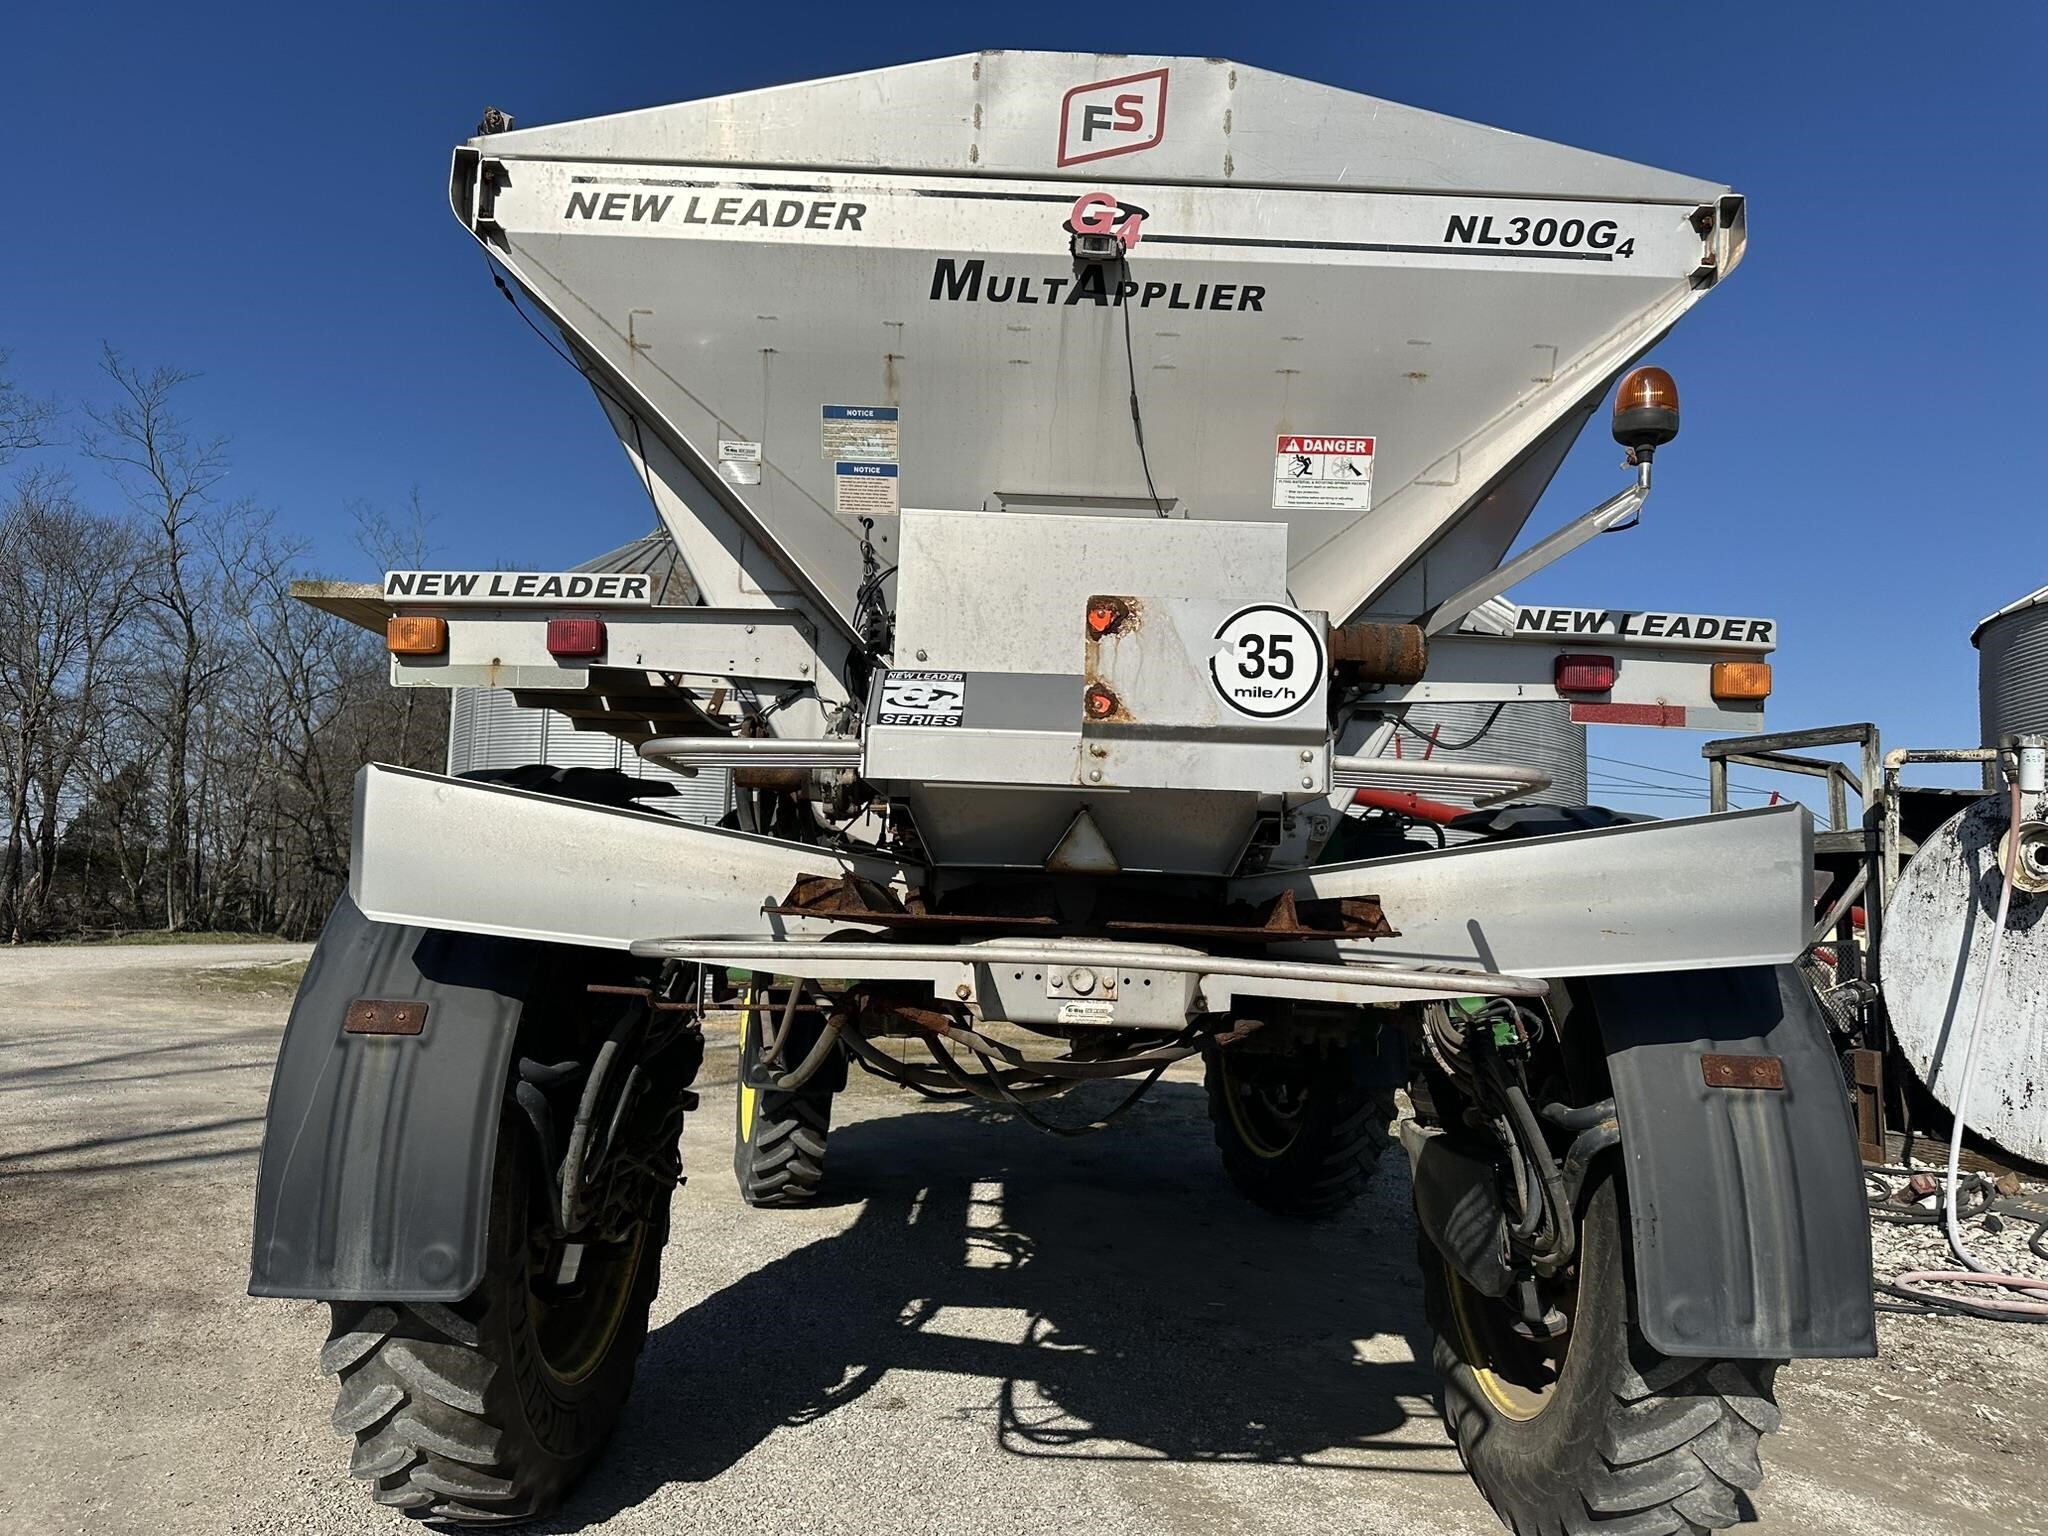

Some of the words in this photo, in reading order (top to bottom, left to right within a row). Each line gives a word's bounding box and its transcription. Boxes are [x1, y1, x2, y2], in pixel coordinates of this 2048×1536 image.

[1082, 94, 1143, 142] FS
[564, 191, 674, 222] NEW
[683, 196, 867, 231] LEADER
[1444, 214, 1635, 259] NL300G4
[846, 409, 874, 417] NOTICE
[1302, 439, 1367, 453] DANGER
[853, 466, 881, 474] NOTICE
[386, 573, 480, 596] NEW
[488, 575, 648, 599] LEADER
[1515, 608, 1609, 633] NEW
[1618, 613, 1773, 643] LEADER
[1238, 633, 1294, 680] 35
[887, 671, 914, 680] NEW
[916, 672, 963, 681] LEADER
[1234, 686, 1296, 699] mile/h
[880, 714, 959, 726] SERIES
